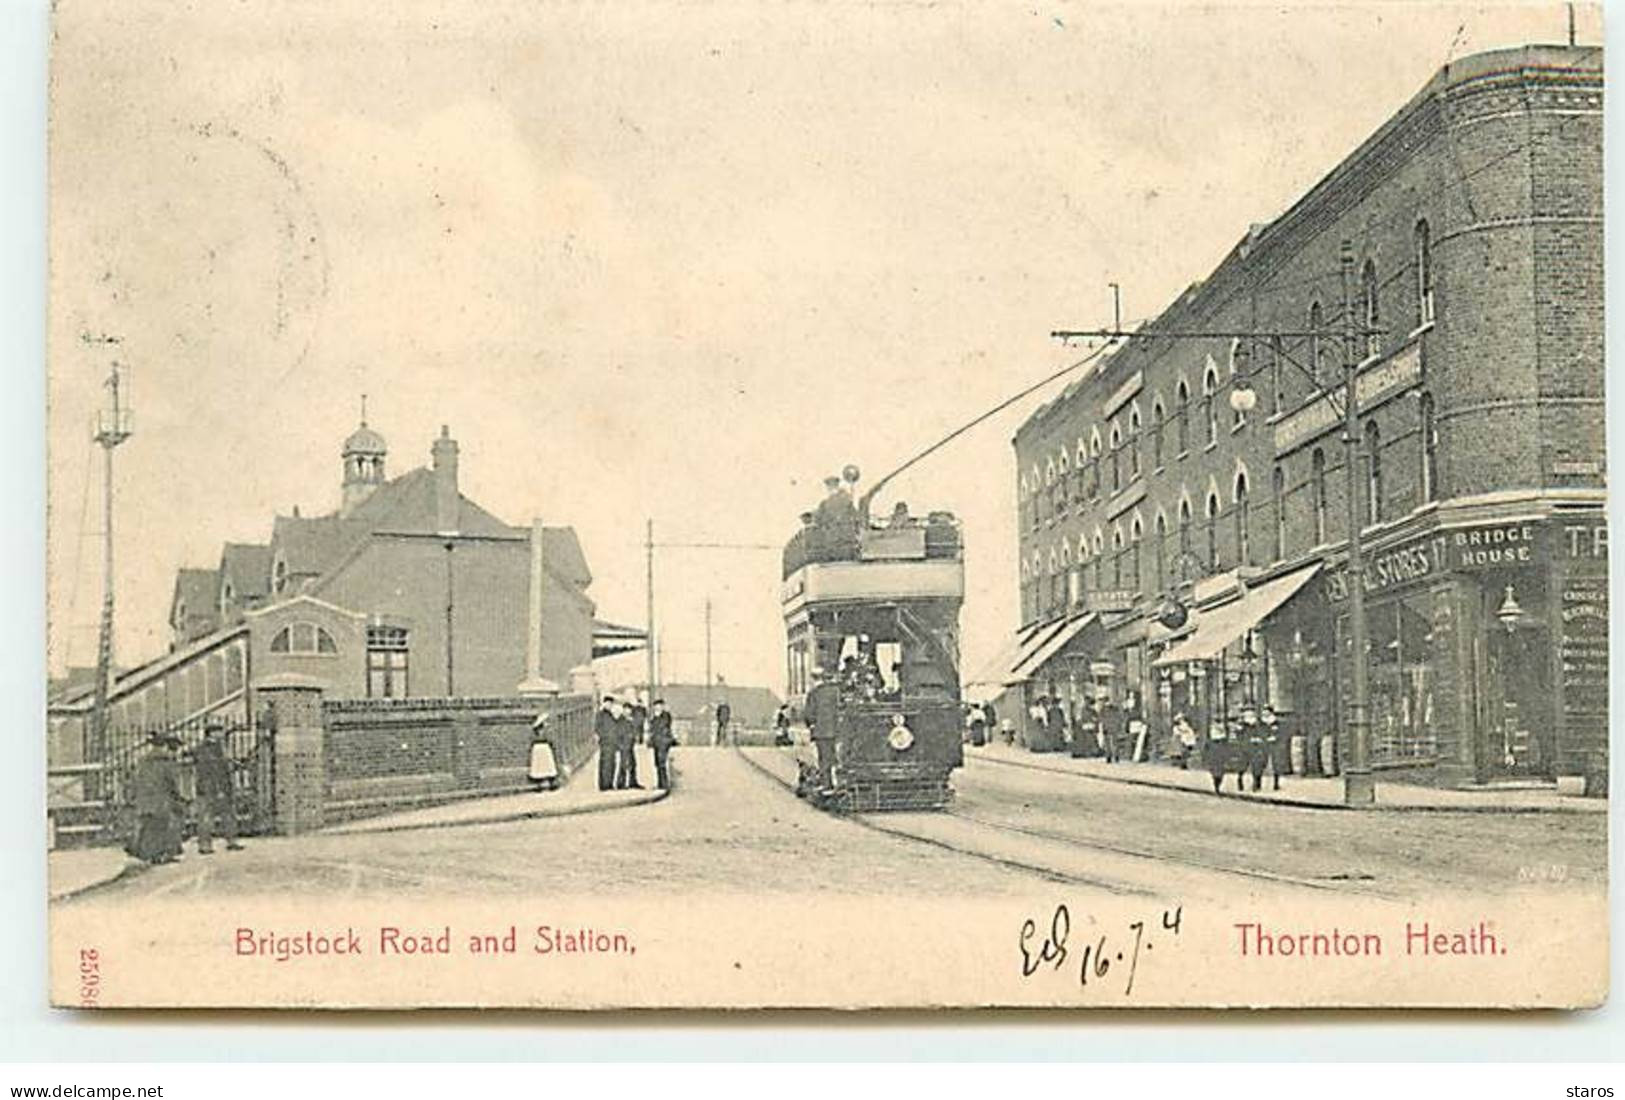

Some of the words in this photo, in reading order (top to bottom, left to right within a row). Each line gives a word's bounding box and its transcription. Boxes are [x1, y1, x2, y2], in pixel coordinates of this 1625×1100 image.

[1456, 526, 1534, 546] BRIDGE
[1377, 545, 1428, 587] STORES
[1461, 547, 1531, 566] HOUSE
[235, 927, 362, 961] Brigstock
[380, 926, 451, 955] Road
[469, 928, 517, 955] and
[534, 926, 637, 957] Station,
[1235, 924, 1382, 956] Thornton
[1406, 922, 1507, 955] Heath.
